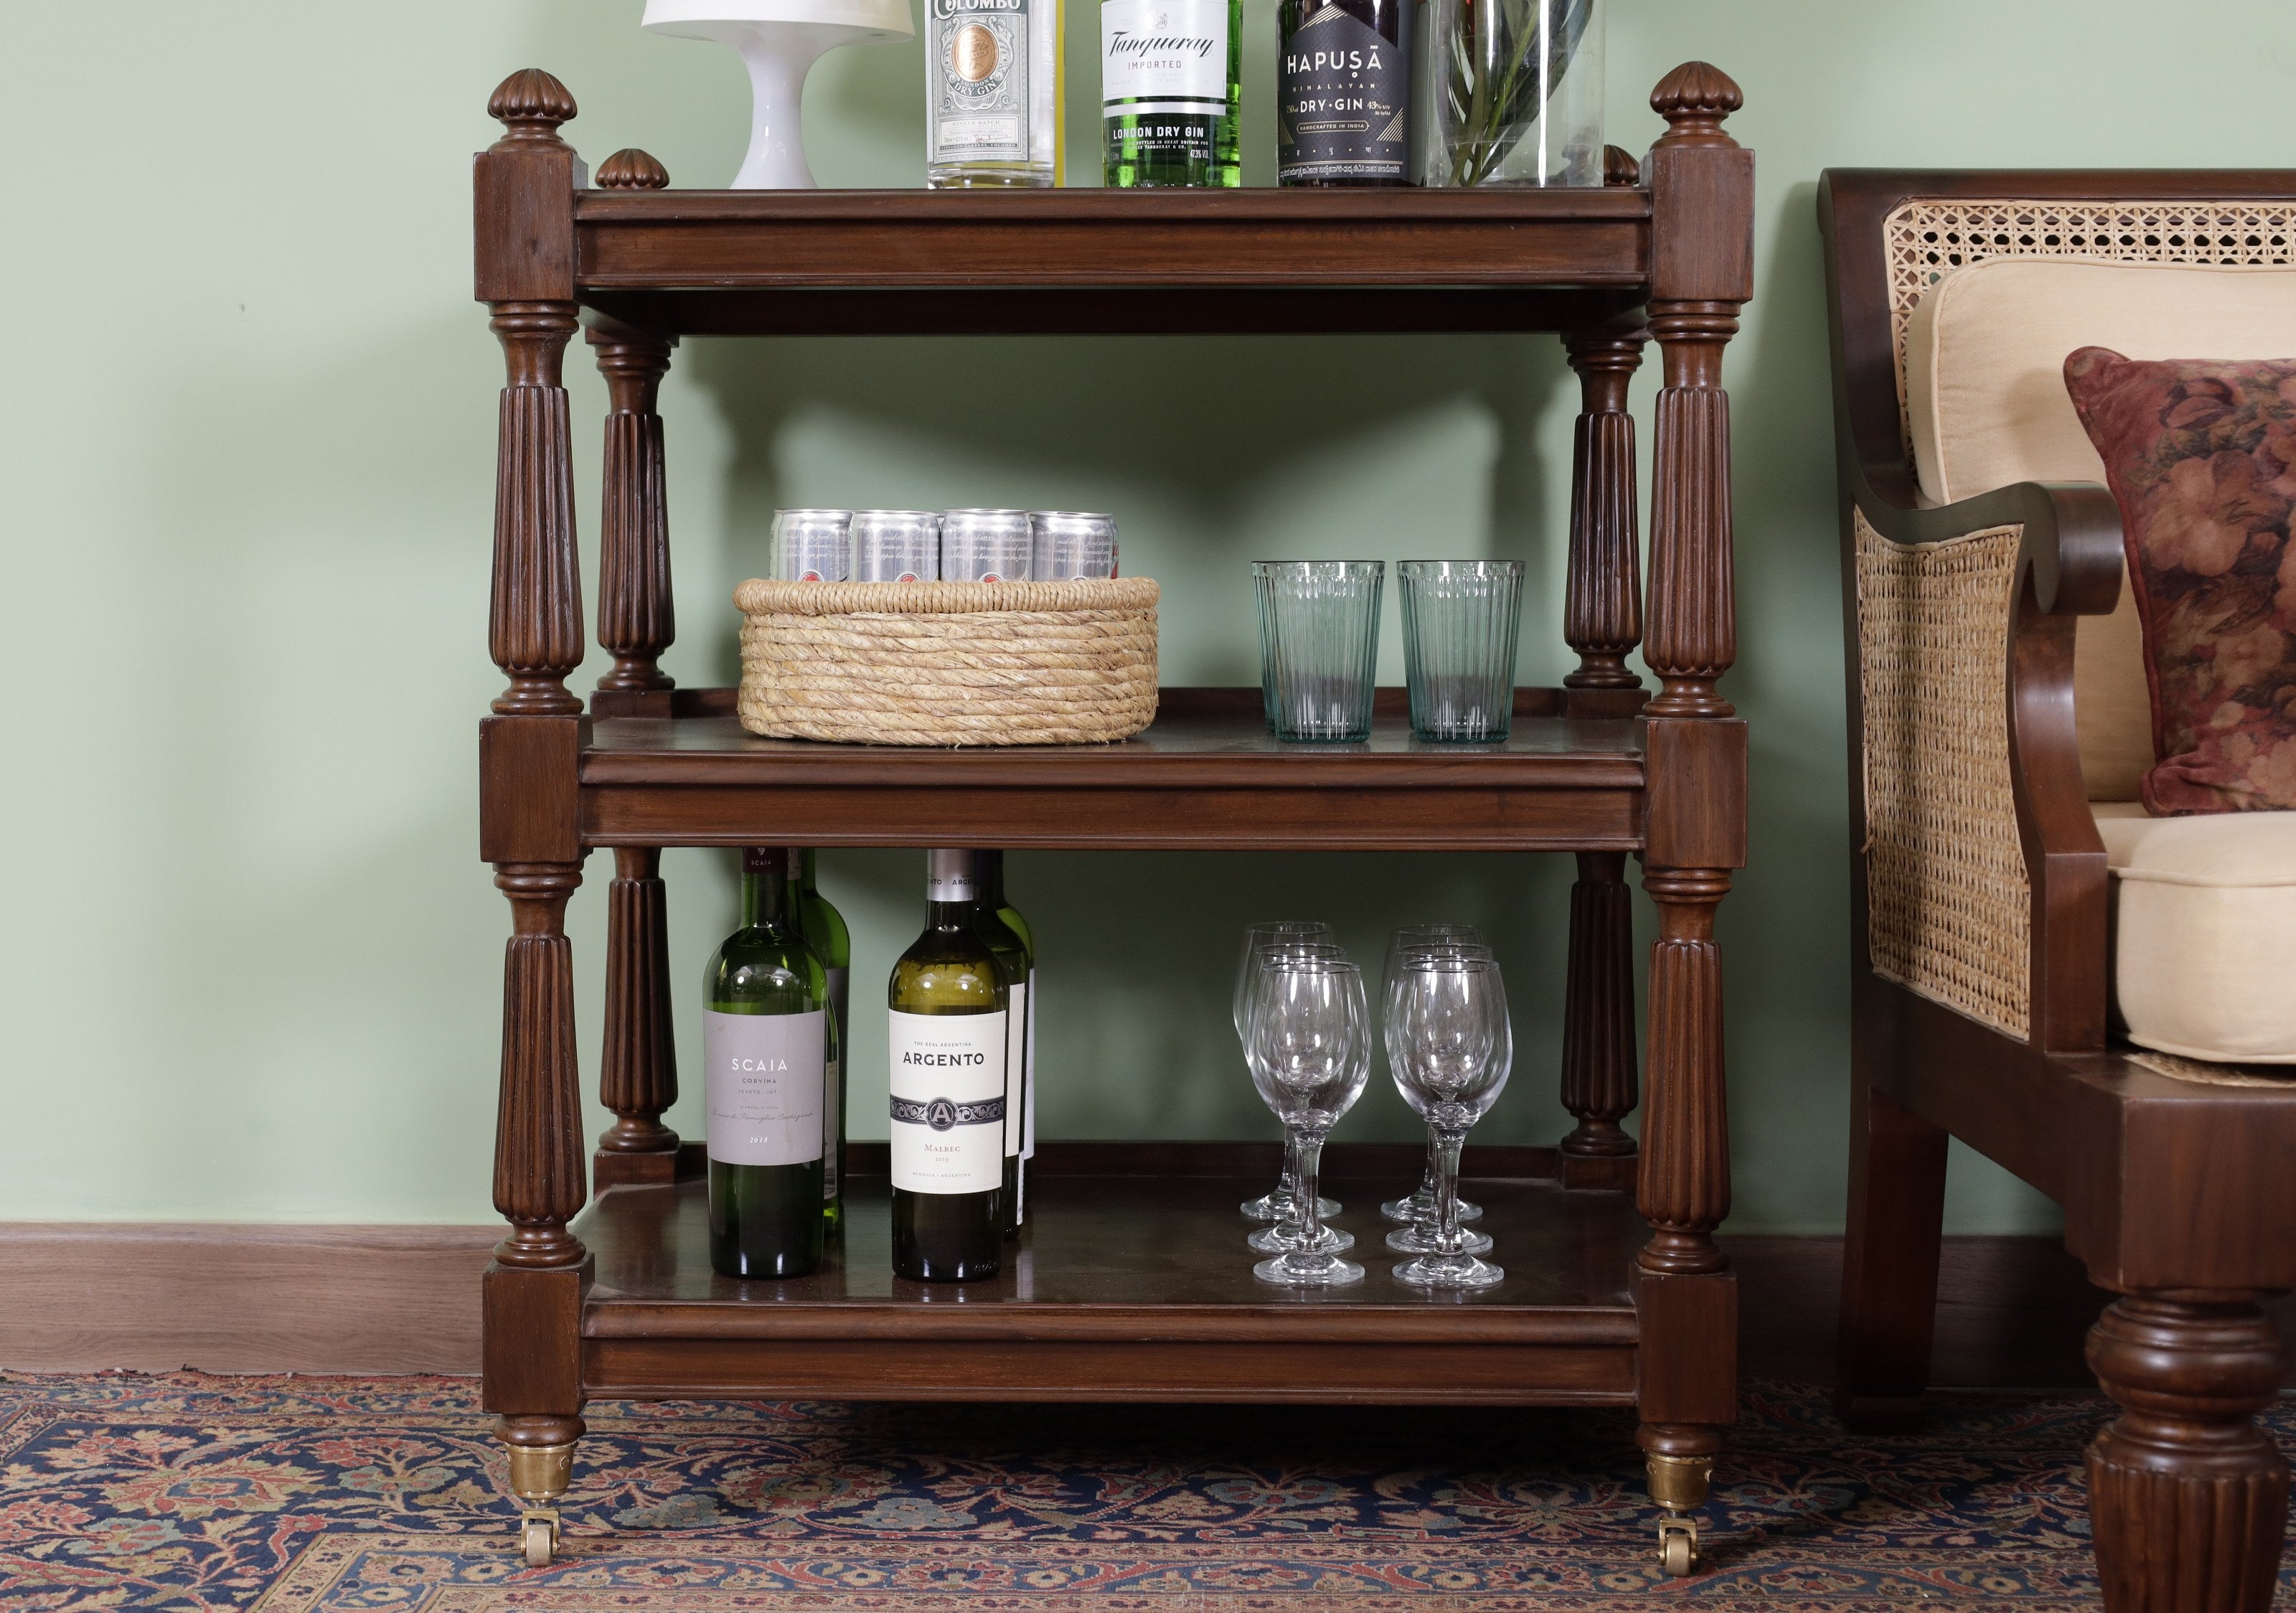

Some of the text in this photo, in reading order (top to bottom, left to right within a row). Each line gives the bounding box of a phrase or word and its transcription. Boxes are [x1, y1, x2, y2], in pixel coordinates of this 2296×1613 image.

[1109, 31, 1214, 57] Tanqueray
[1128, 61, 1182, 70] IMPORTED
[954, 80, 997, 96] DRY GIN
[1292, 83, 1375, 92] HIMALAYAN
[1300, 99, 1327, 113] DRY
[1335, 98, 1363, 110] GIN
[1113, 126, 1204, 140] LONDON DRY GIN
[732, 1058, 788, 1071] SCAIA
[903, 1051, 984, 1066] ARGENTO
